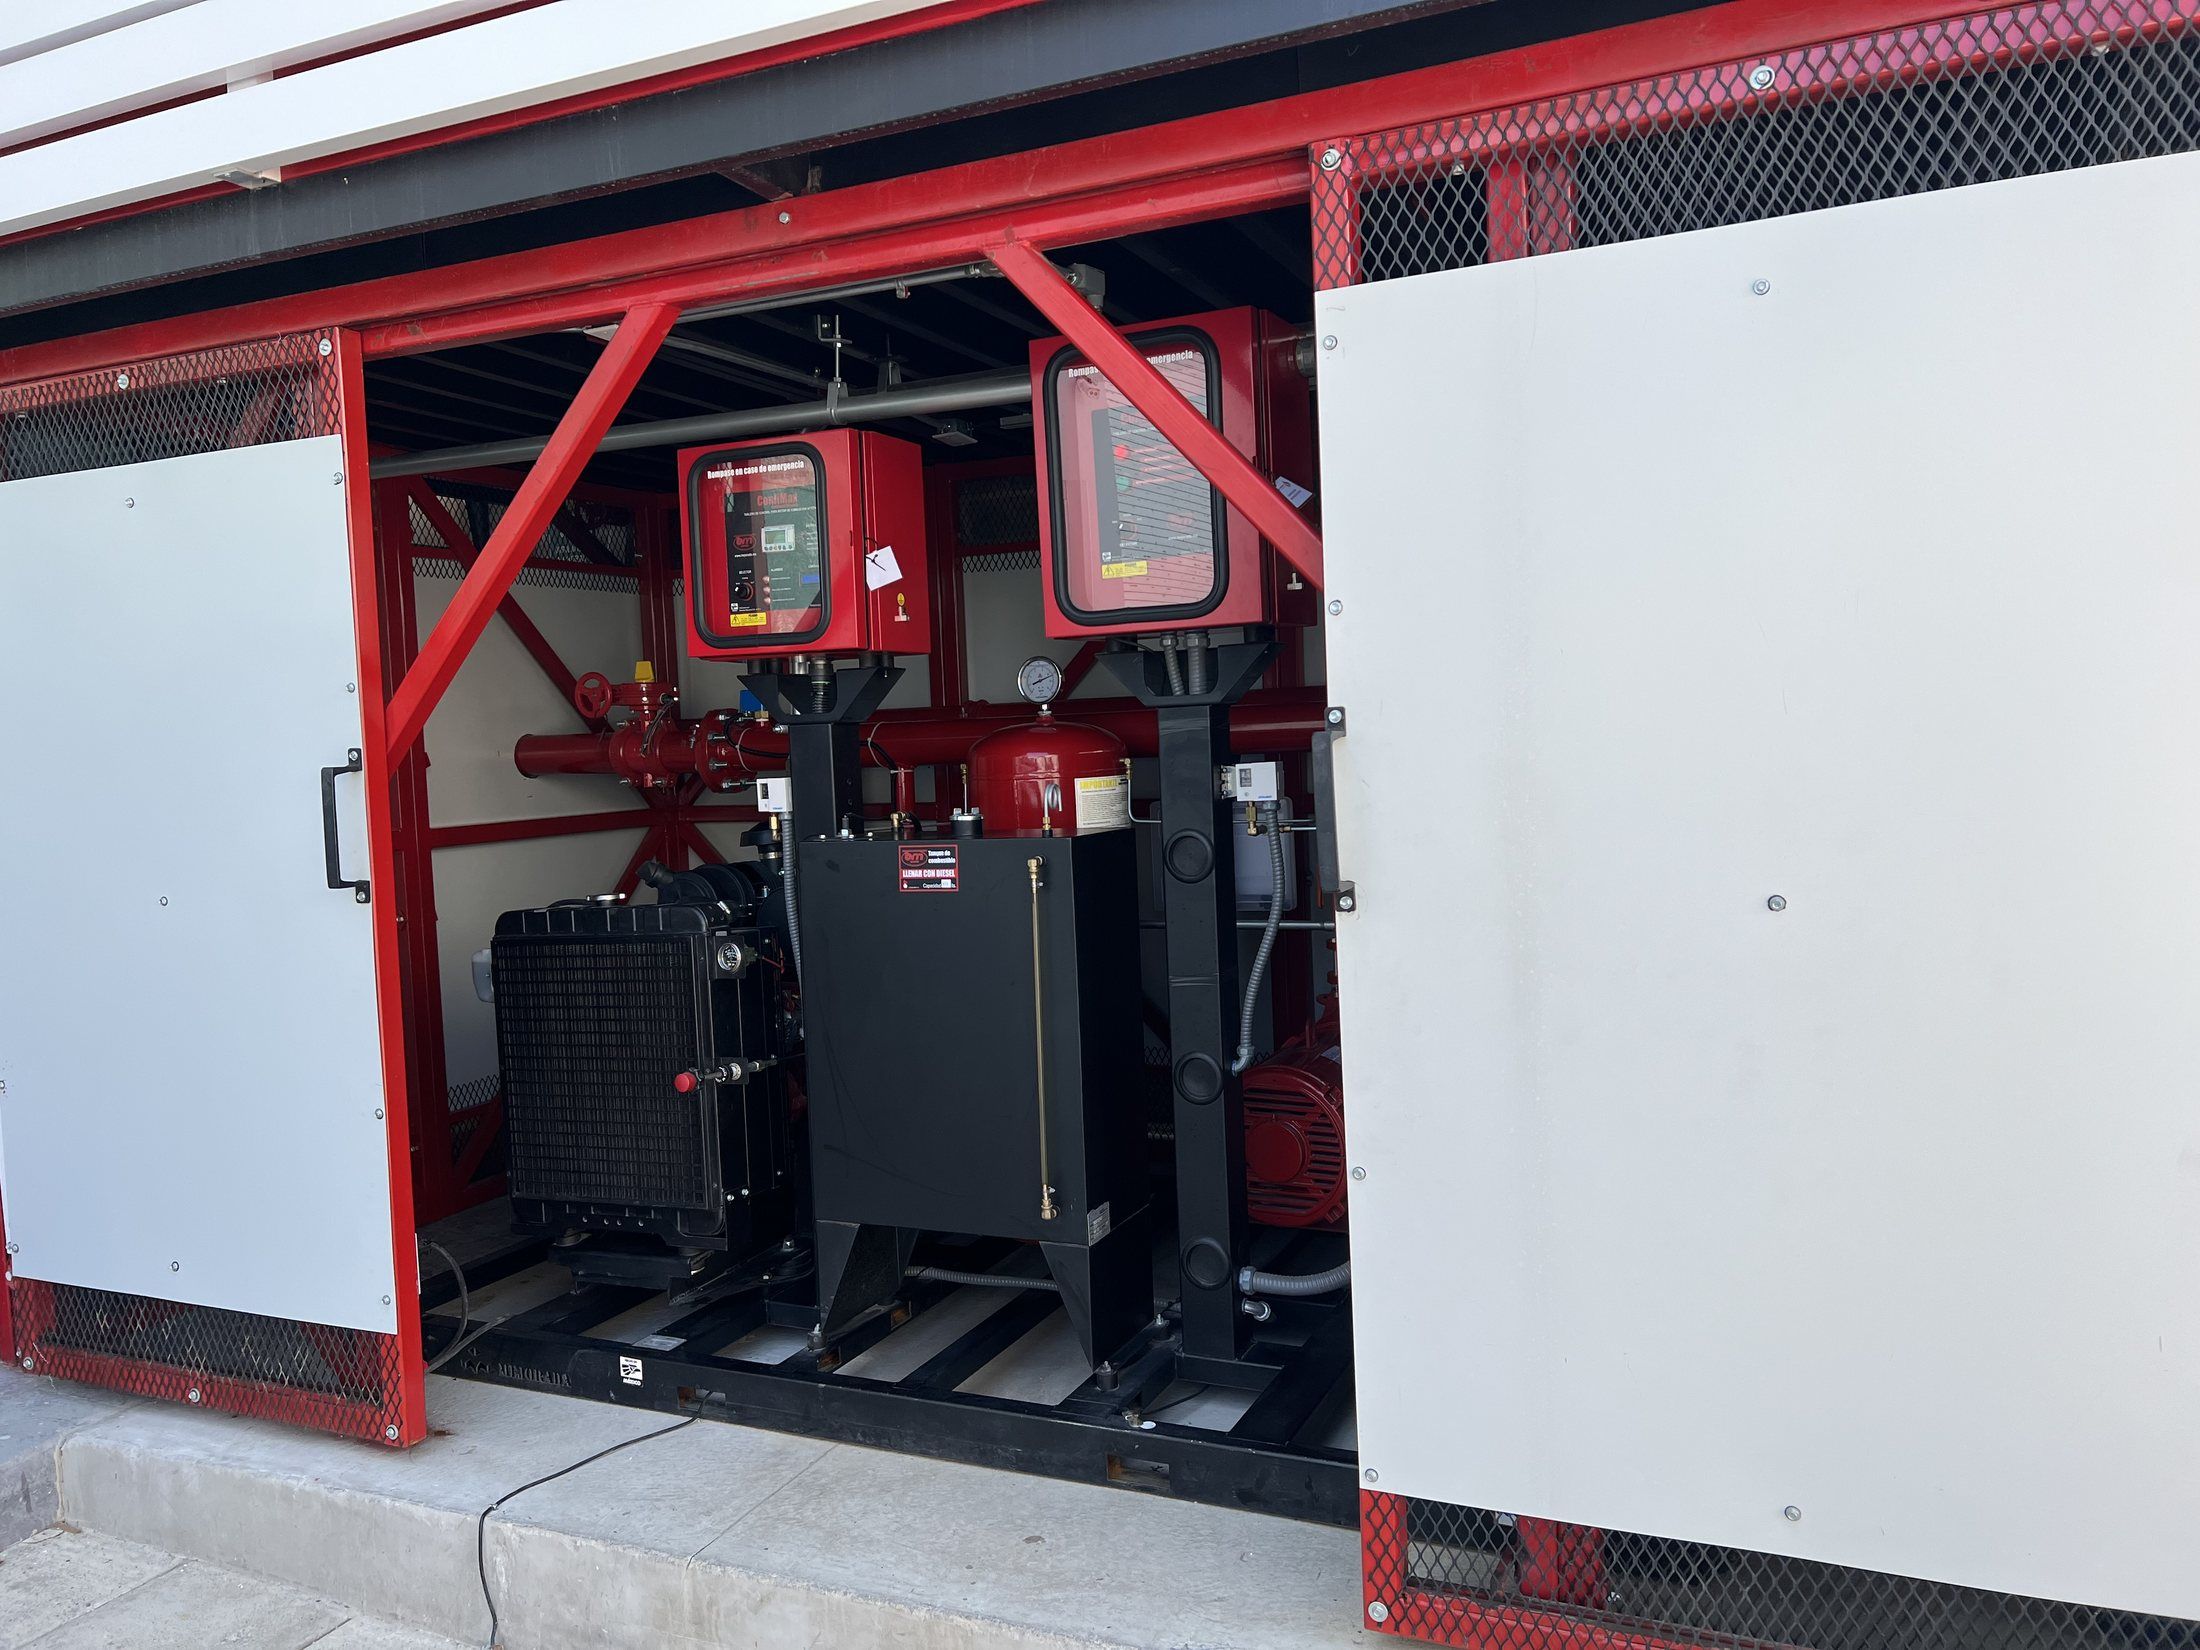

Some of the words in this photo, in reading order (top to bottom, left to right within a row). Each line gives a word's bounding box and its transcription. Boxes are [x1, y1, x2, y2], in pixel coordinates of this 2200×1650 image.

[1068, 365, 1098, 378] Rompas
[735, 467, 743, 476] en
[759, 464, 767, 473] de
[767, 460, 805, 472] emergencia
[902, 869, 923, 878] LLENAR
[923, 869, 936, 878] CON
[936, 869, 956, 878] DIESEL
